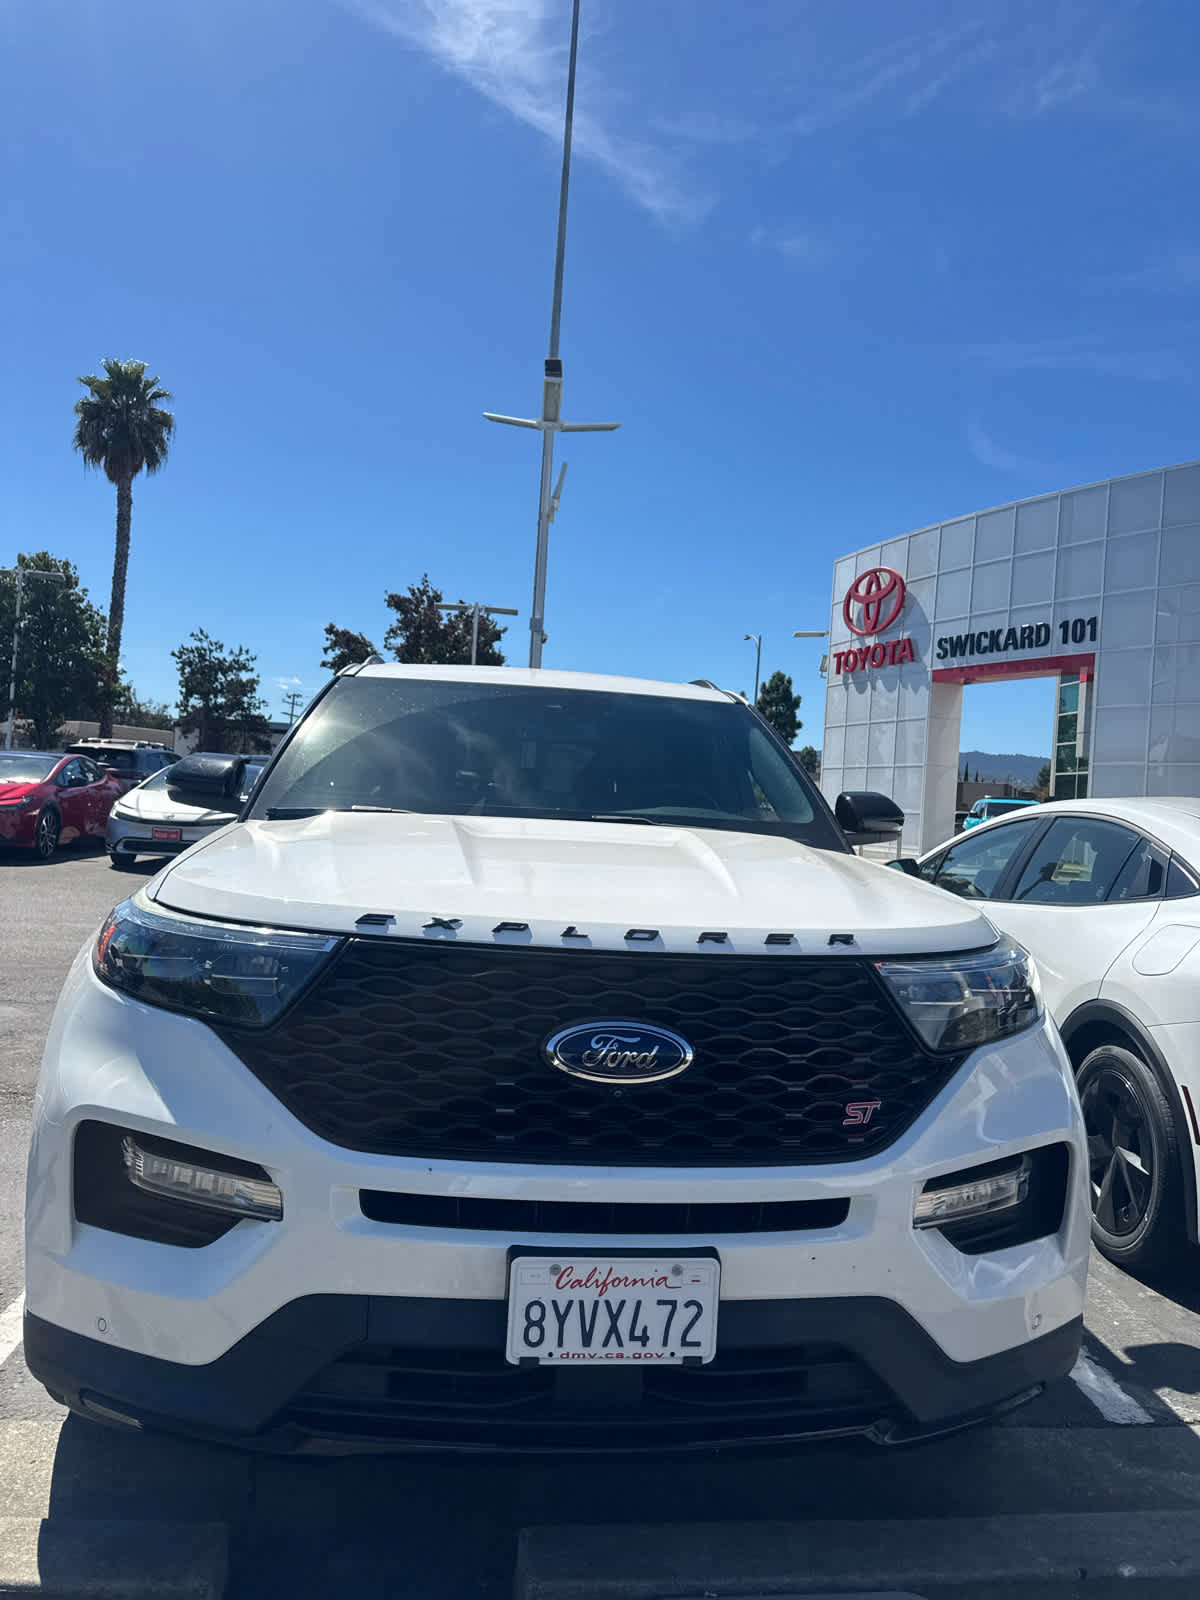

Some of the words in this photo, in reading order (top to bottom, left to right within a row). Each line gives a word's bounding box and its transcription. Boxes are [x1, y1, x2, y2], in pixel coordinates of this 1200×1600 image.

[936, 622, 1051, 660] SWICKARD
[1058, 616, 1098, 645] 101
[833, 637, 915, 675] TOYOTA
[355, 912, 855, 946] EXPLORER
[582, 1033, 658, 1069] Ford
[842, 1101, 882, 1126] ST
[555, 1265, 682, 1297] California
[522, 1299, 704, 1348] 8YVX472
[559, 1351, 665, 1360] dmv.ca.gov
